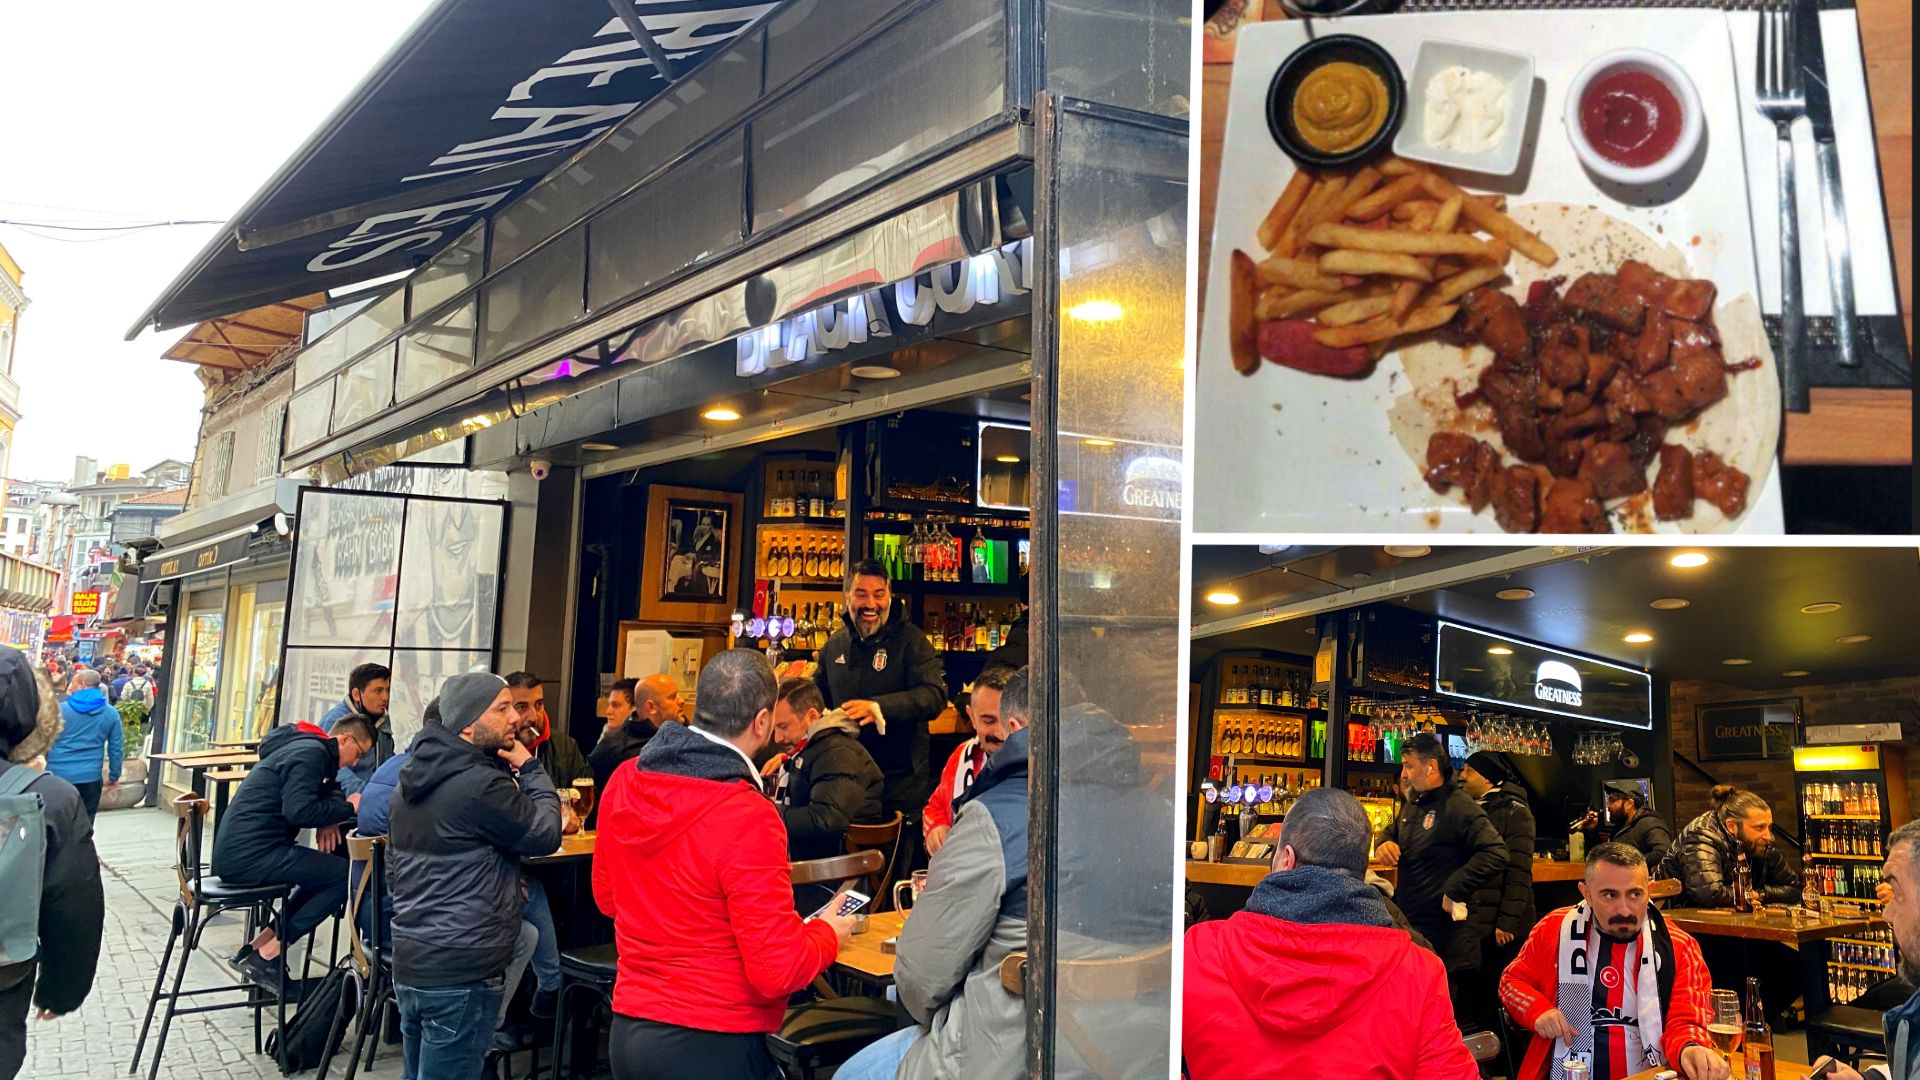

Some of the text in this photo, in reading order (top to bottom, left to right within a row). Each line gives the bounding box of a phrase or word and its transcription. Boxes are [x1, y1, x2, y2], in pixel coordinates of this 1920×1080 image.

[306, 0, 786, 273] REATNESS
[1535, 682, 1583, 707] GREATNESS
[1714, 724, 1783, 739] GREATNESS
